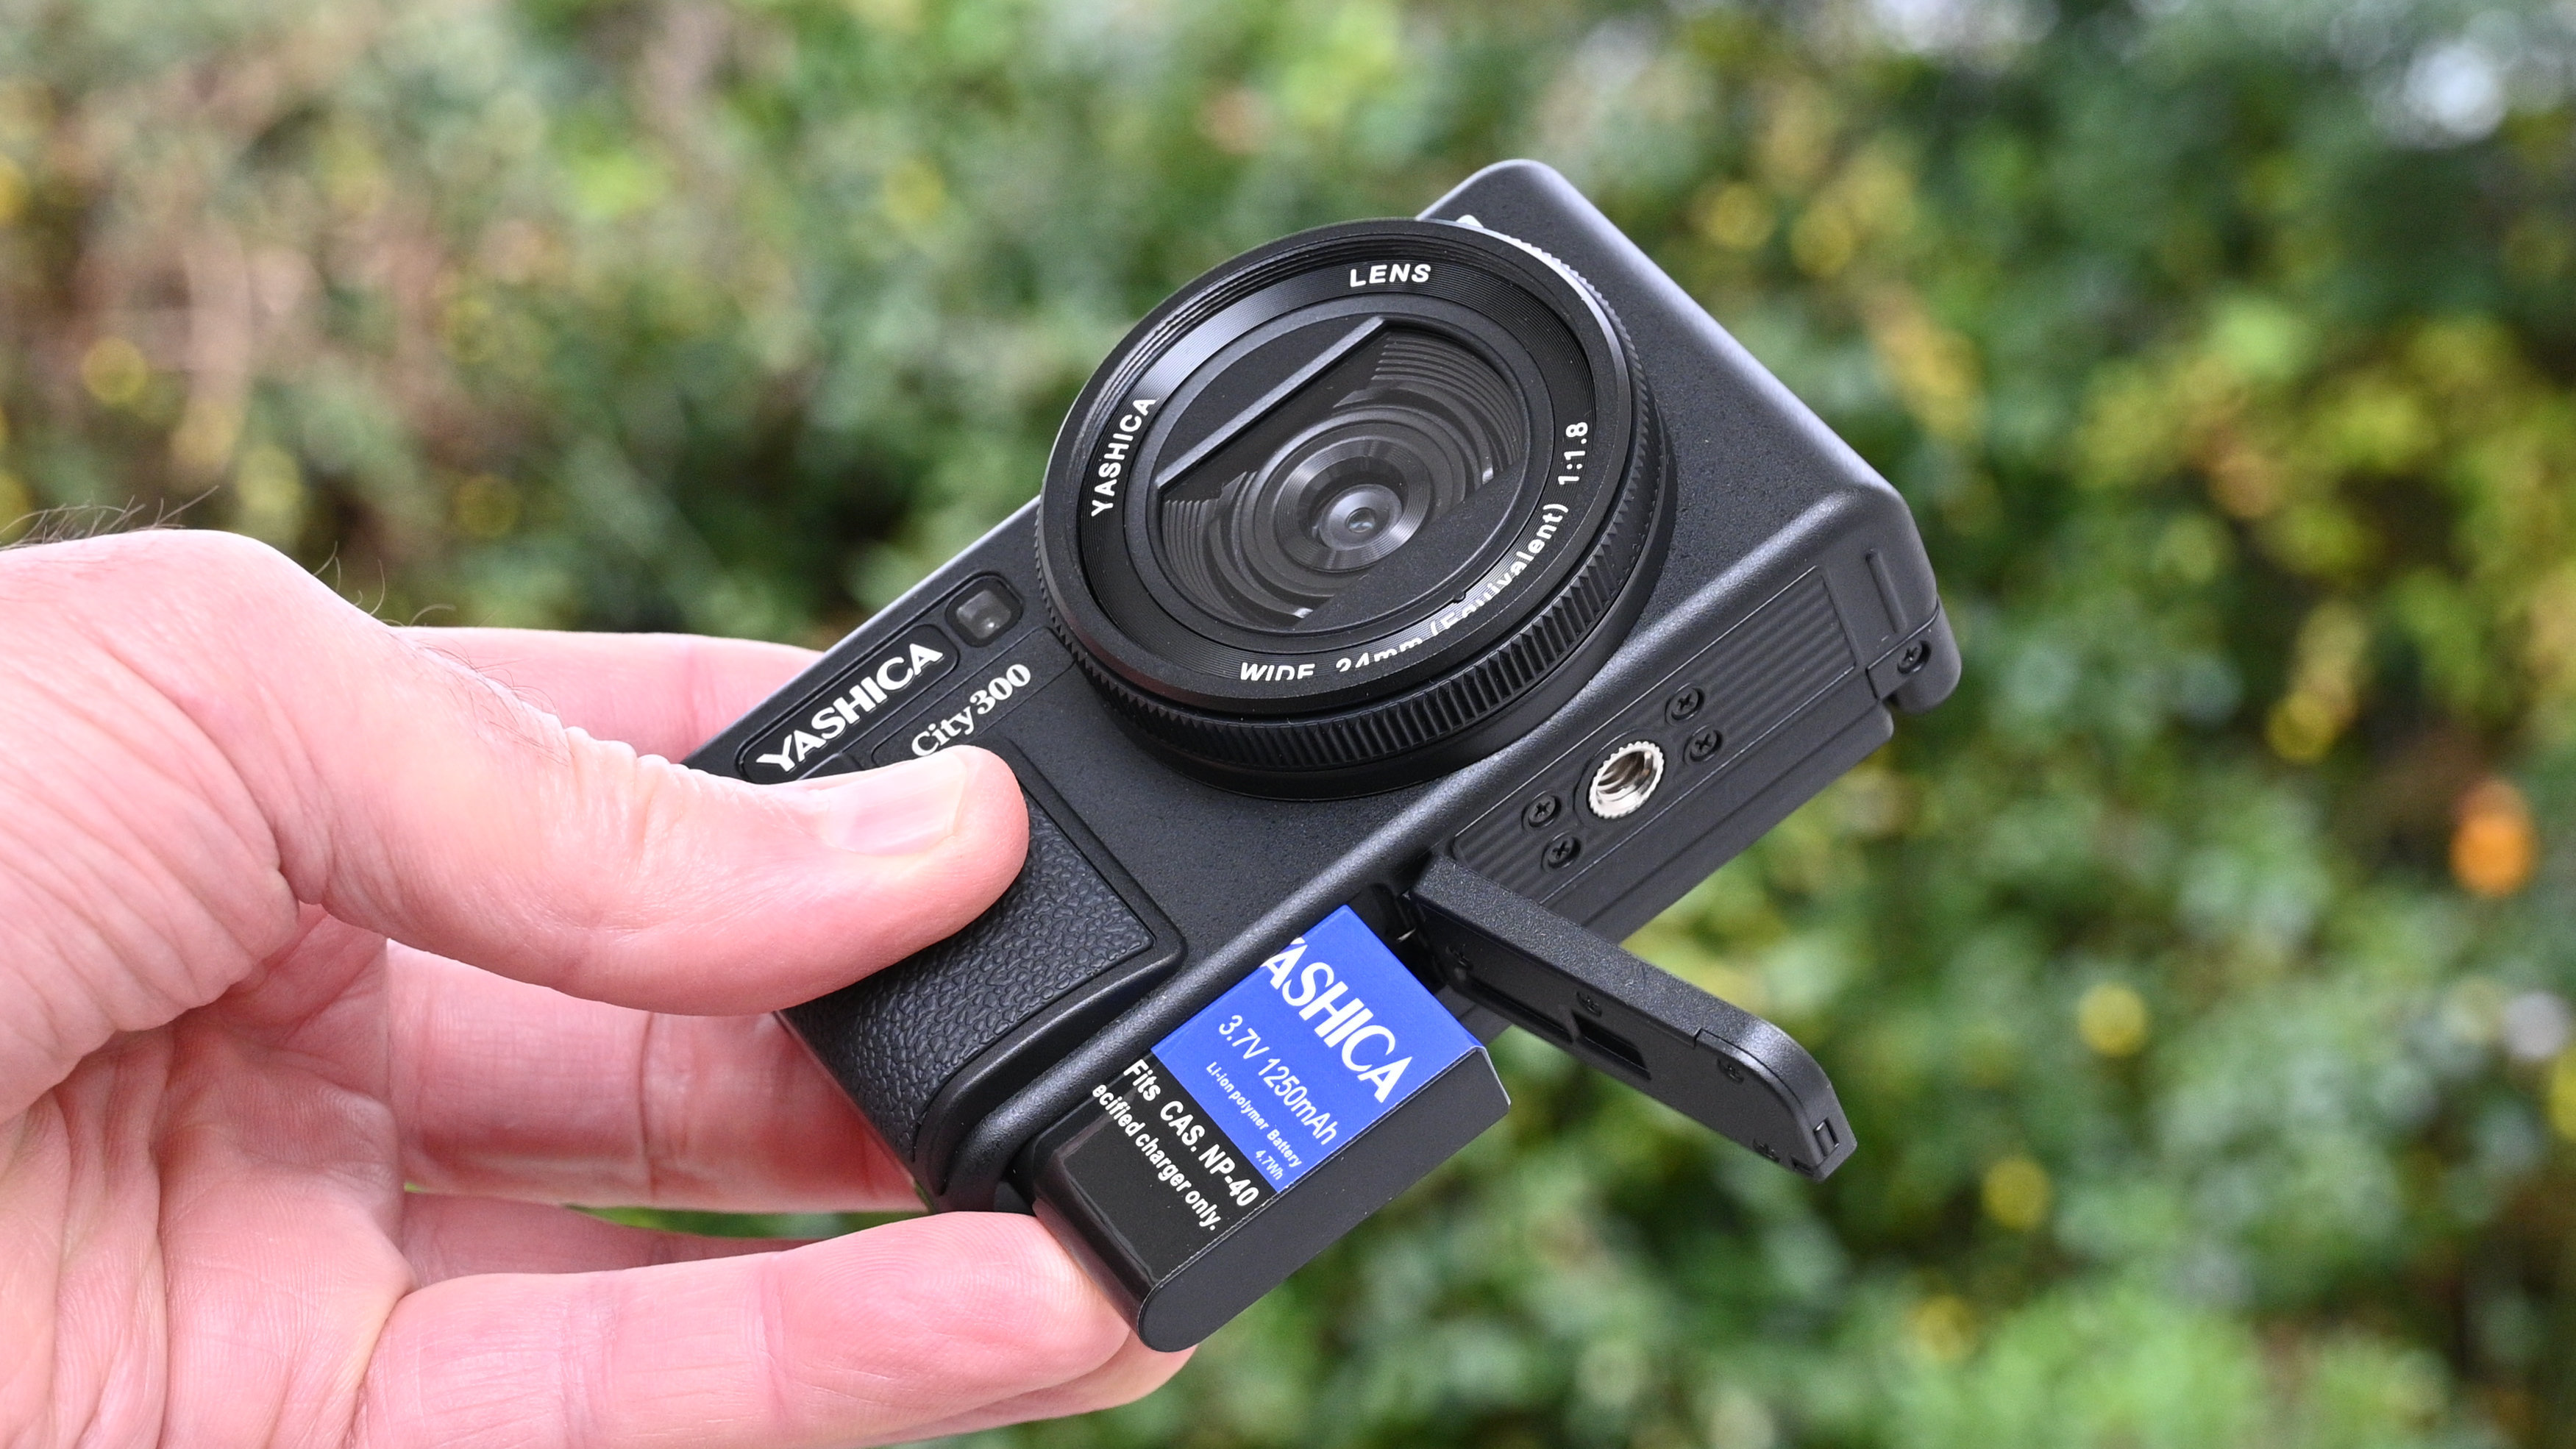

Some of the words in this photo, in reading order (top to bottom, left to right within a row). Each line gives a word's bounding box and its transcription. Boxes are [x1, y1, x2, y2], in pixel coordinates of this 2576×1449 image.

[1091, 396, 1157, 517] YASHICA
[1350, 263, 1431, 288] LENS
[1557, 421, 1588, 485] 1:1.8
[755, 643, 944, 772] YASHICA
[1218, 1014, 1270, 1060] 3.7V
[1258, 1058, 1338, 1145] 1250mAh
[1260, 936, 1413, 1103] ASHICA
[1122, 1058, 1161, 1102] Fits
[1160, 1100, 1206, 1153] CAS.
[1198, 1143, 1259, 1207] NP-40
[1206, 1061, 1235, 1093] Li-ion
[1228, 1090, 1270, 1130] polymer
[1267, 1128, 1303, 1168] Battery
[1256, 1150, 1284, 1181] 4.7Wh
[1135, 1133, 1192, 1192] charger
[1184, 1190, 1222, 1231] only.
